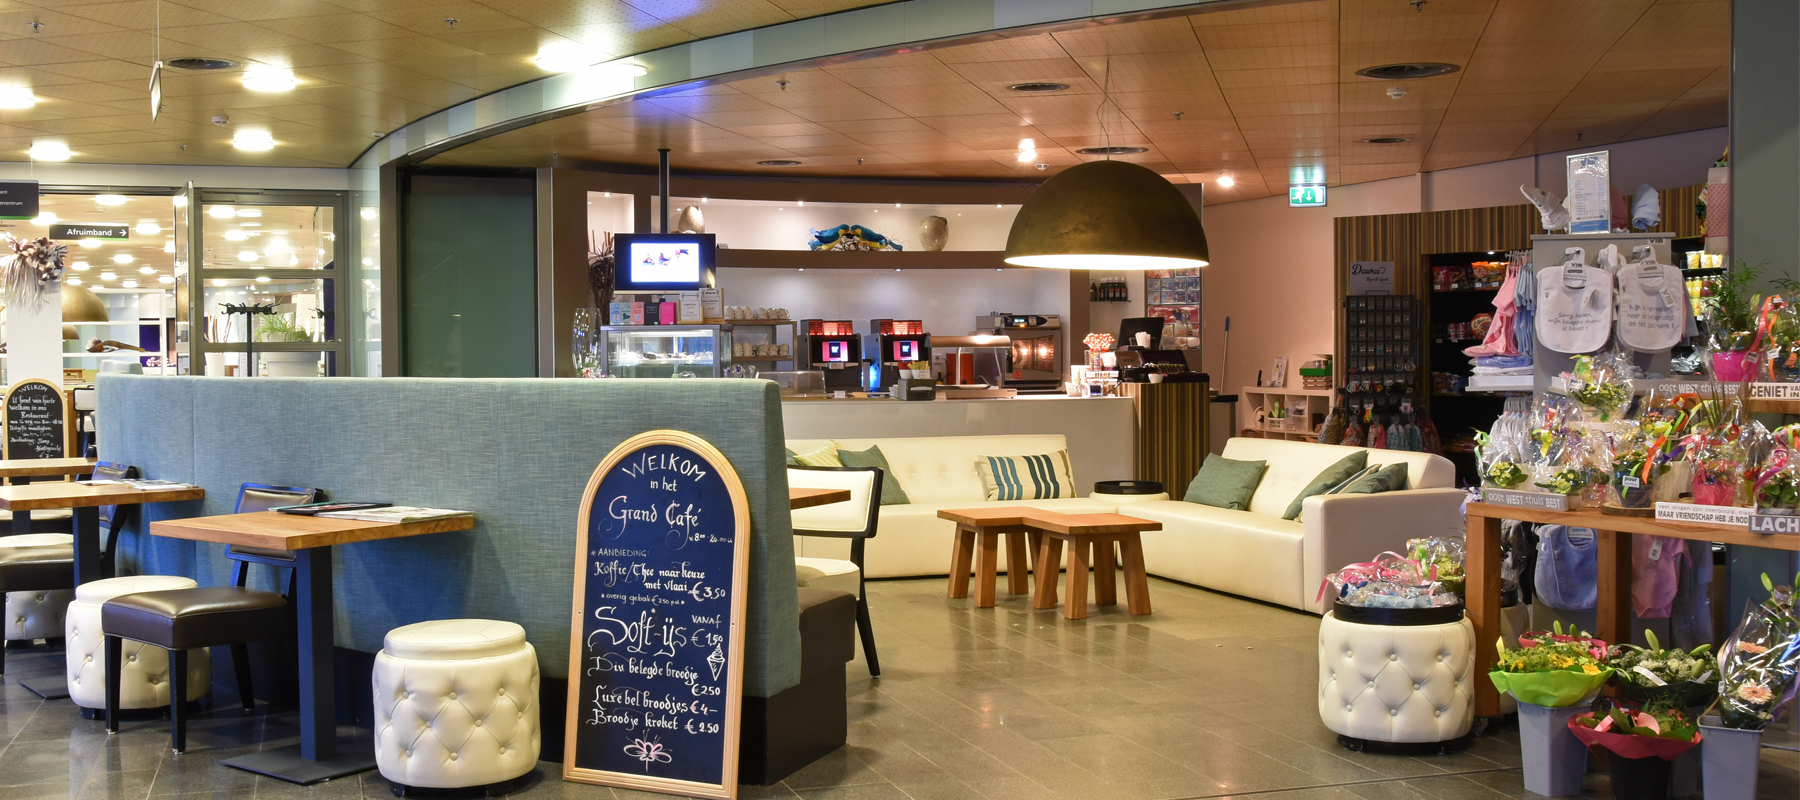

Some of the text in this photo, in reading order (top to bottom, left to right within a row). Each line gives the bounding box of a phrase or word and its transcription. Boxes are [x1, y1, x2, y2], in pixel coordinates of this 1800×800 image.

[66, 227, 113, 236] Afruimband
[18, 384, 48, 393] WELKOM
[1659, 383, 1677, 393] oost
[1678, 383, 1698, 394] WEST
[1724, 384, 1740, 394] BEST
[1750, 385, 1788, 398] GENIET
[621, 452, 707, 482] WELKOM
[650, 476, 678, 492] in het
[1488, 493, 1561, 509] oost WEST thuis BEST
[601, 495, 702, 541] Grand Café
[1657, 510, 1675, 519] MAAR
[1675, 511, 1714, 521] VRIENDSCHAP
[1715, 514, 1727, 522] HEB
[1728, 515, 1735, 523] JE
[1751, 516, 1800, 533] LACH
[597, 547, 650, 558] AANBIEDING:
[658, 568, 680, 578] naar
[680, 561, 706, 579] keuze
[643, 579, 661, 590] met
[663, 579, 688, 592] vlaai
[606, 593, 627, 606] overig
[629, 593, 650, 606] gebak
[629, 657, 663, 679] belegde
[666, 661, 699, 686] broodje
[592, 684, 622, 711] Luxe
[643, 690, 688, 715] broodjes
[586, 708, 639, 731] Broodje
[645, 711, 678, 730] kroket
